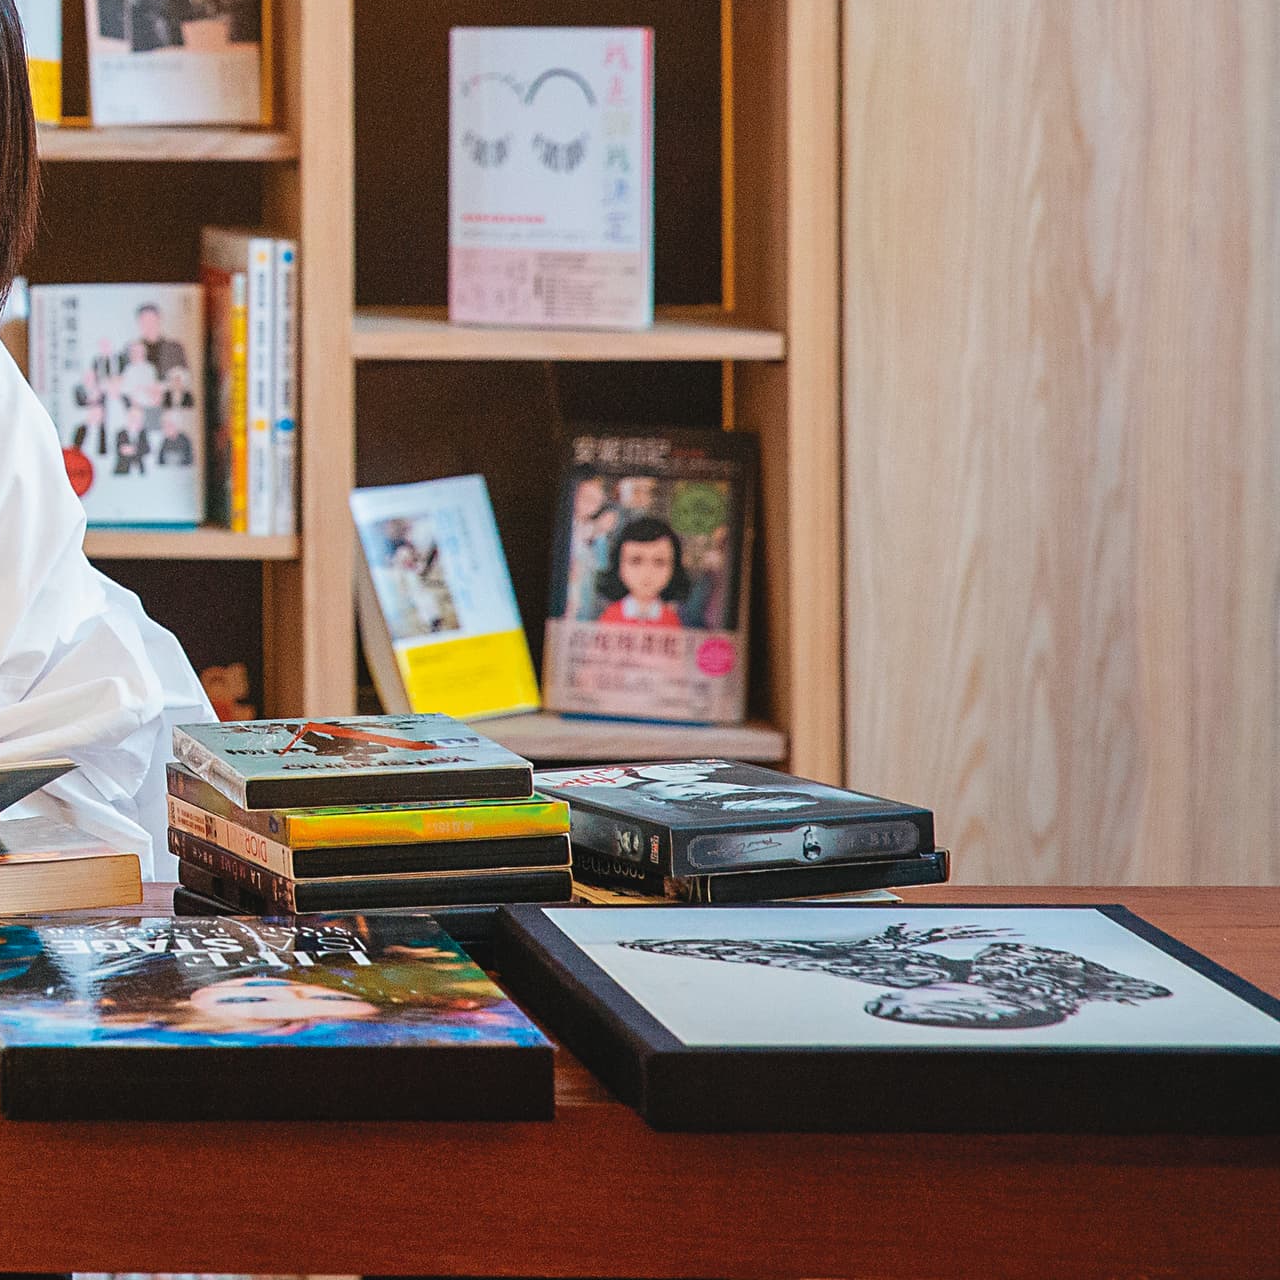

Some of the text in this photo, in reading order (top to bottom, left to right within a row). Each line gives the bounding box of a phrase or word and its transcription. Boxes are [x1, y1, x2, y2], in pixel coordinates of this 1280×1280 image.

[54, 937, 243, 954] STAGE
[317, 936, 367, 952] IS
[175, 950, 372, 967] LIFE
